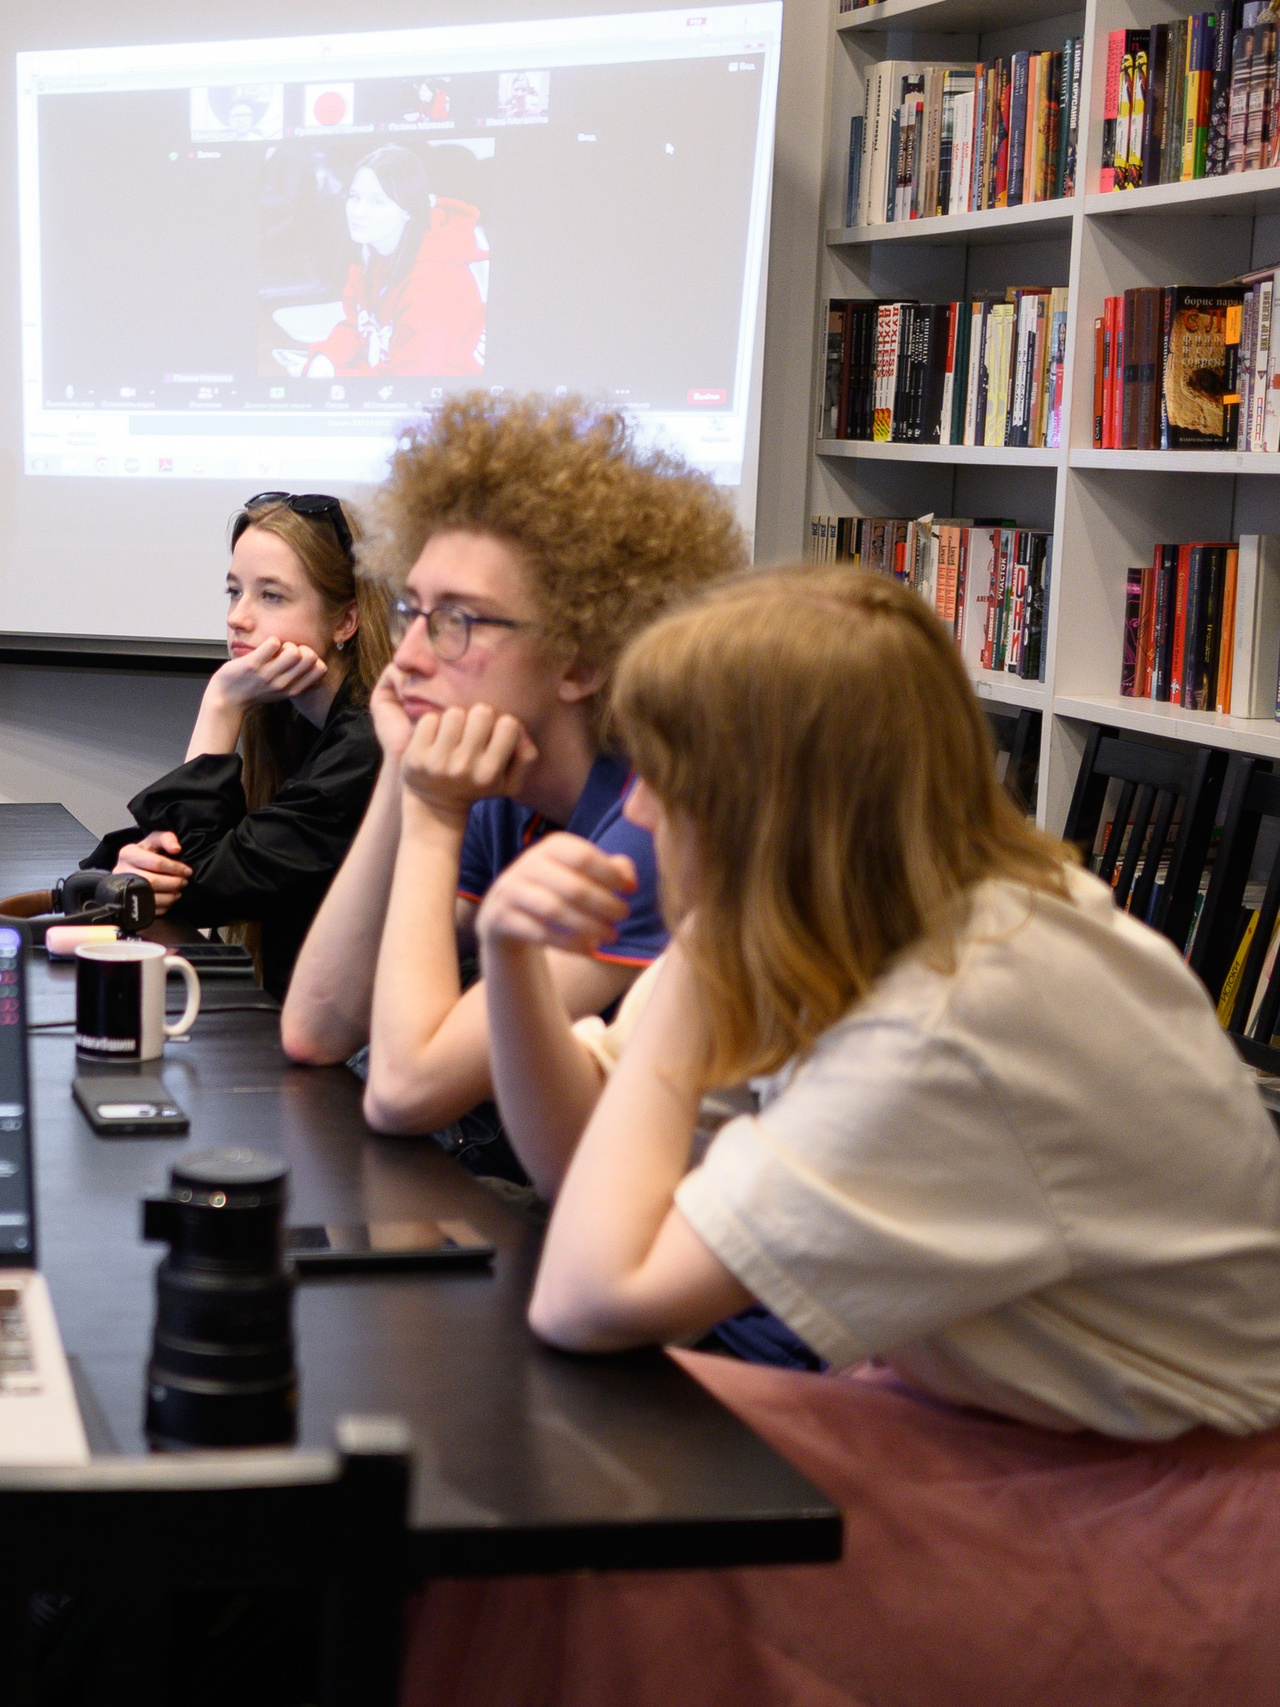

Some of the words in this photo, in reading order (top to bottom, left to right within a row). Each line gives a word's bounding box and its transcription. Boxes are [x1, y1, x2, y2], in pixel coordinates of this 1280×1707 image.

[1073, 50, 1081, 80] ПАВЕЛ
[1070, 82, 1079, 129] КРУСАНОВ
[1184, 296, 1214, 308] борис
[1262, 290, 1271, 322] ПЕЛЕВИН
[1183, 308, 1224, 334] СЛ
[1260, 324, 1269, 351] ВИКТОР
[1160, 398, 1168, 430] борис
[998, 557, 1007, 600] УЧАСТОК
